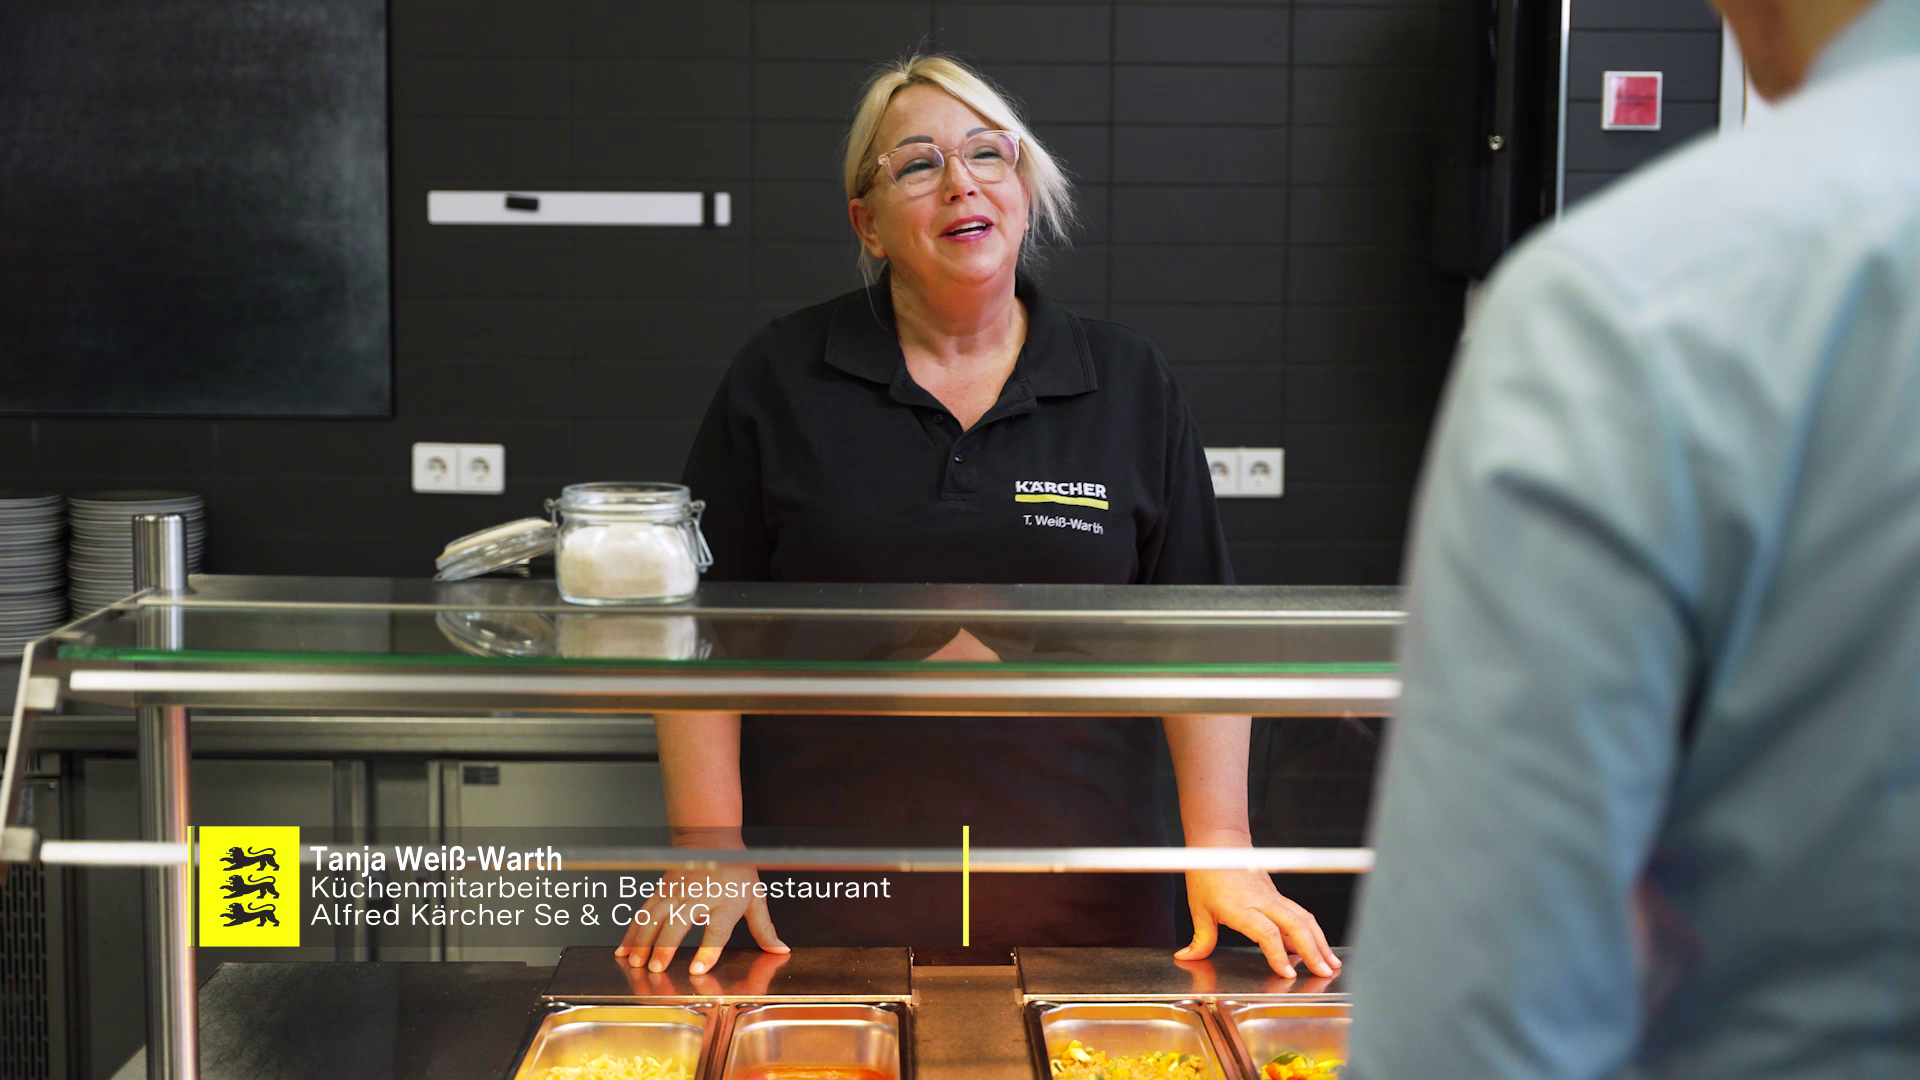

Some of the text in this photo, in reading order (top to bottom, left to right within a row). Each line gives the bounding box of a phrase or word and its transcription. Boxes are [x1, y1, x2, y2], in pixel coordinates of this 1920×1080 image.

[1015, 480, 1107, 499] KÄRCHER
[1023, 514, 1104, 535] T. Weiß-Warth
